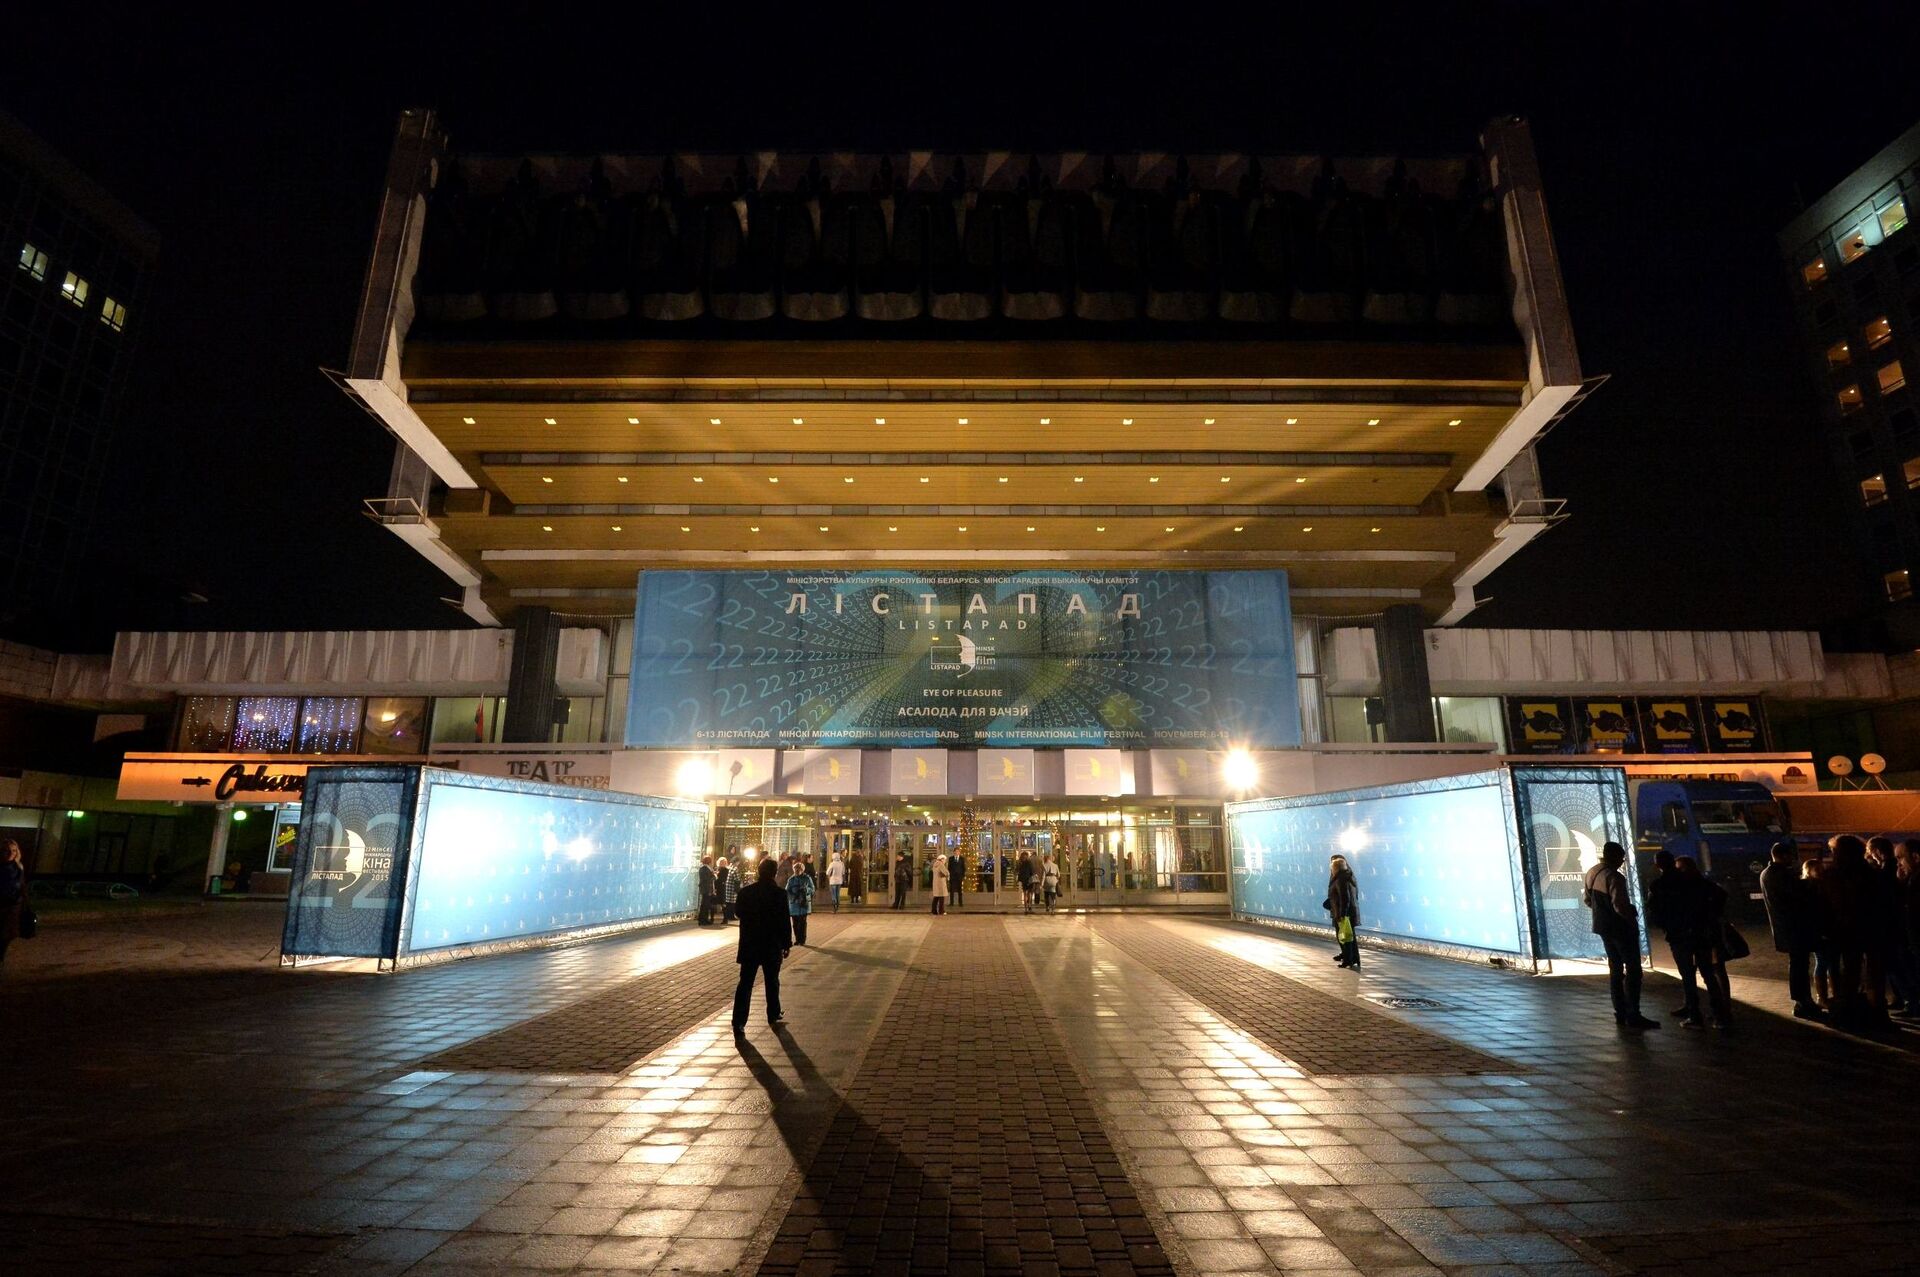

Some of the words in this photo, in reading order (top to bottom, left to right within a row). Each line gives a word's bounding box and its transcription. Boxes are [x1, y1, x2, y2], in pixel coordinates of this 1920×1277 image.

[743, 571, 779, 599] 22
[1146, 571, 1180, 600] 22
[785, 593, 1141, 619] ЛІСТАПАД
[813, 594, 831, 609] 22
[716, 599, 756, 630] 22
[758, 616, 785, 638] 22
[787, 626, 808, 642] 22
[810, 633, 827, 646] 22
[798, 608, 818, 624] 22
[817, 618, 833, 631] 22
[899, 620, 1027, 630] LISTAPAD
[1118, 627, 1137, 643] 22
[1140, 616, 1167, 638] 22
[1169, 600, 1208, 631] 22
[706, 642, 744, 671] 22
[752, 646, 778, 666] 22
[784, 649, 804, 663] 22
[808, 650, 823, 661] 22
[975, 655, 996, 665] film
[1103, 651, 1117, 661] 22
[1122, 649, 1140, 663] 22
[1147, 647, 1172, 666] 22
[1178, 643, 1218, 670] 22
[712, 683, 753, 717] 22
[756, 674, 783, 698] 22
[786, 670, 806, 687] 22
[809, 666, 825, 679] 22
[770, 699, 797, 723] 22
[795, 688, 815, 706] 22
[815, 681, 831, 695] 22
[923, 689, 939, 697] EYE
[942, 689, 954, 697] OF
[956, 689, 1003, 697] PLEASURE
[1095, 682, 1110, 695] 22
[1110, 689, 1130, 706] 22
[1129, 699, 1155, 723] 22
[1101, 666, 1116, 679] 22
[1119, 670, 1139, 687] 22
[1142, 675, 1169, 698] 22
[1172, 683, 1212, 715] 22
[809, 704, 827, 722] 22
[824, 694, 840, 708] 22
[897, 707, 957, 718] АСАЛОДА
[959, 707, 986, 718] ДЛЯ
[989, 704, 1029, 717] ВАЧЭЙ
[1084, 718, 1100, 729] 22
[506, 760, 576, 782] ТЕАТР
[311, 873, 344, 881] ЛІСТАПАД
[1549, 874, 1583, 882] ЛІСТАПАД
